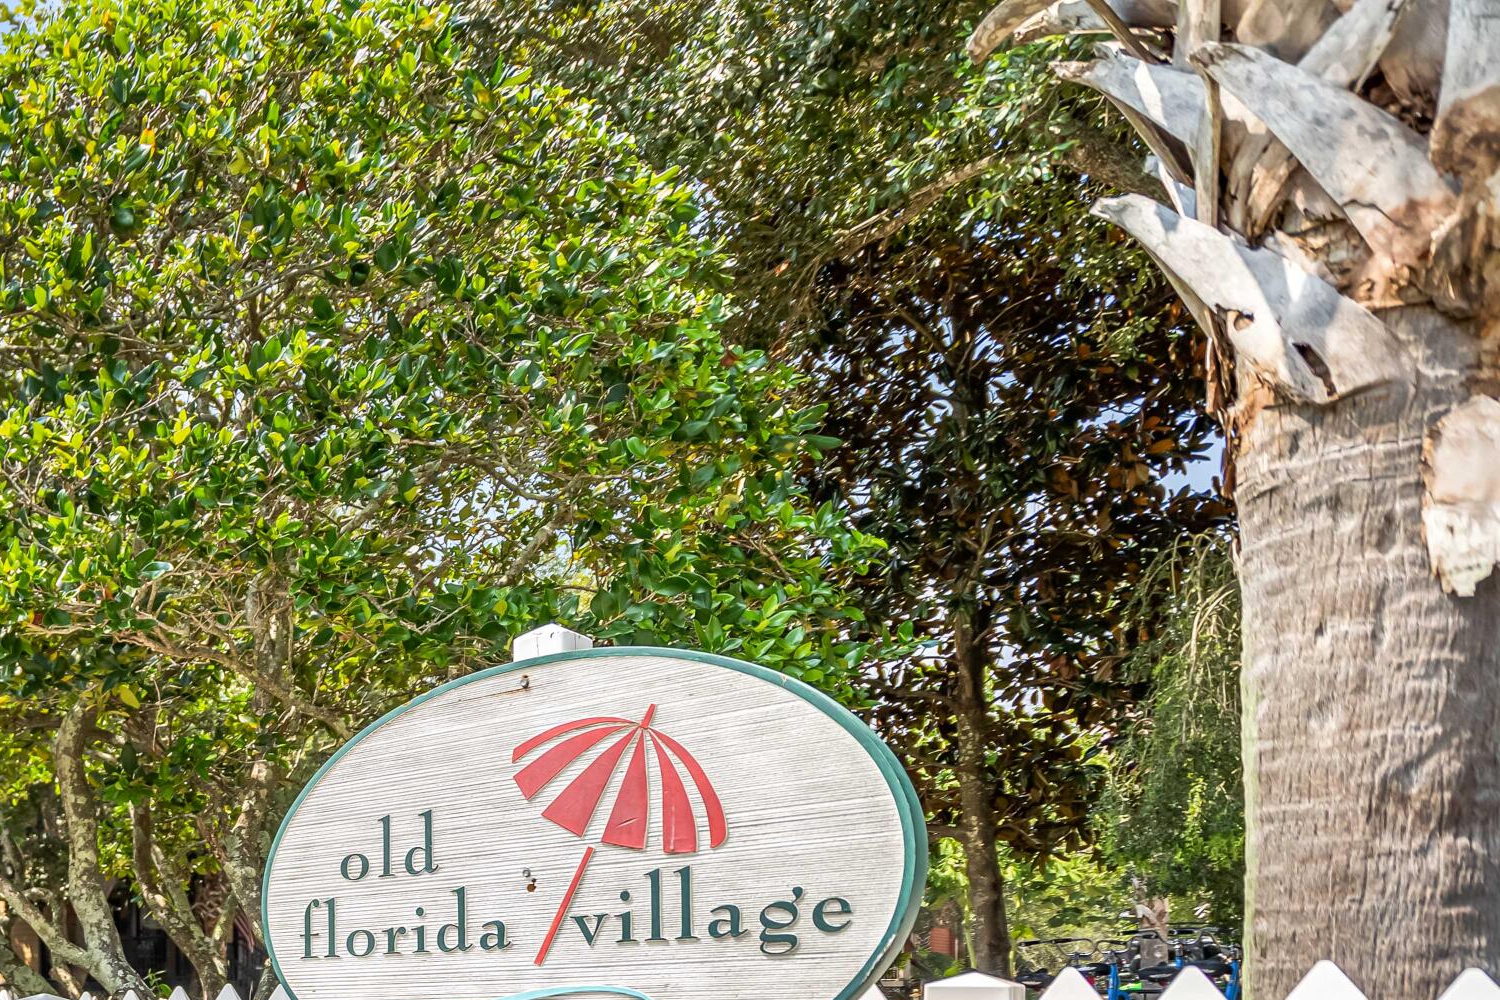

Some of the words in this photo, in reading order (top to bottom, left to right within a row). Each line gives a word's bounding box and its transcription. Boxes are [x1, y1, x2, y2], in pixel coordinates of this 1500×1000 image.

[340, 809, 439, 881] old
[300, 886, 512, 960] florida
[570, 865, 853, 955] village
